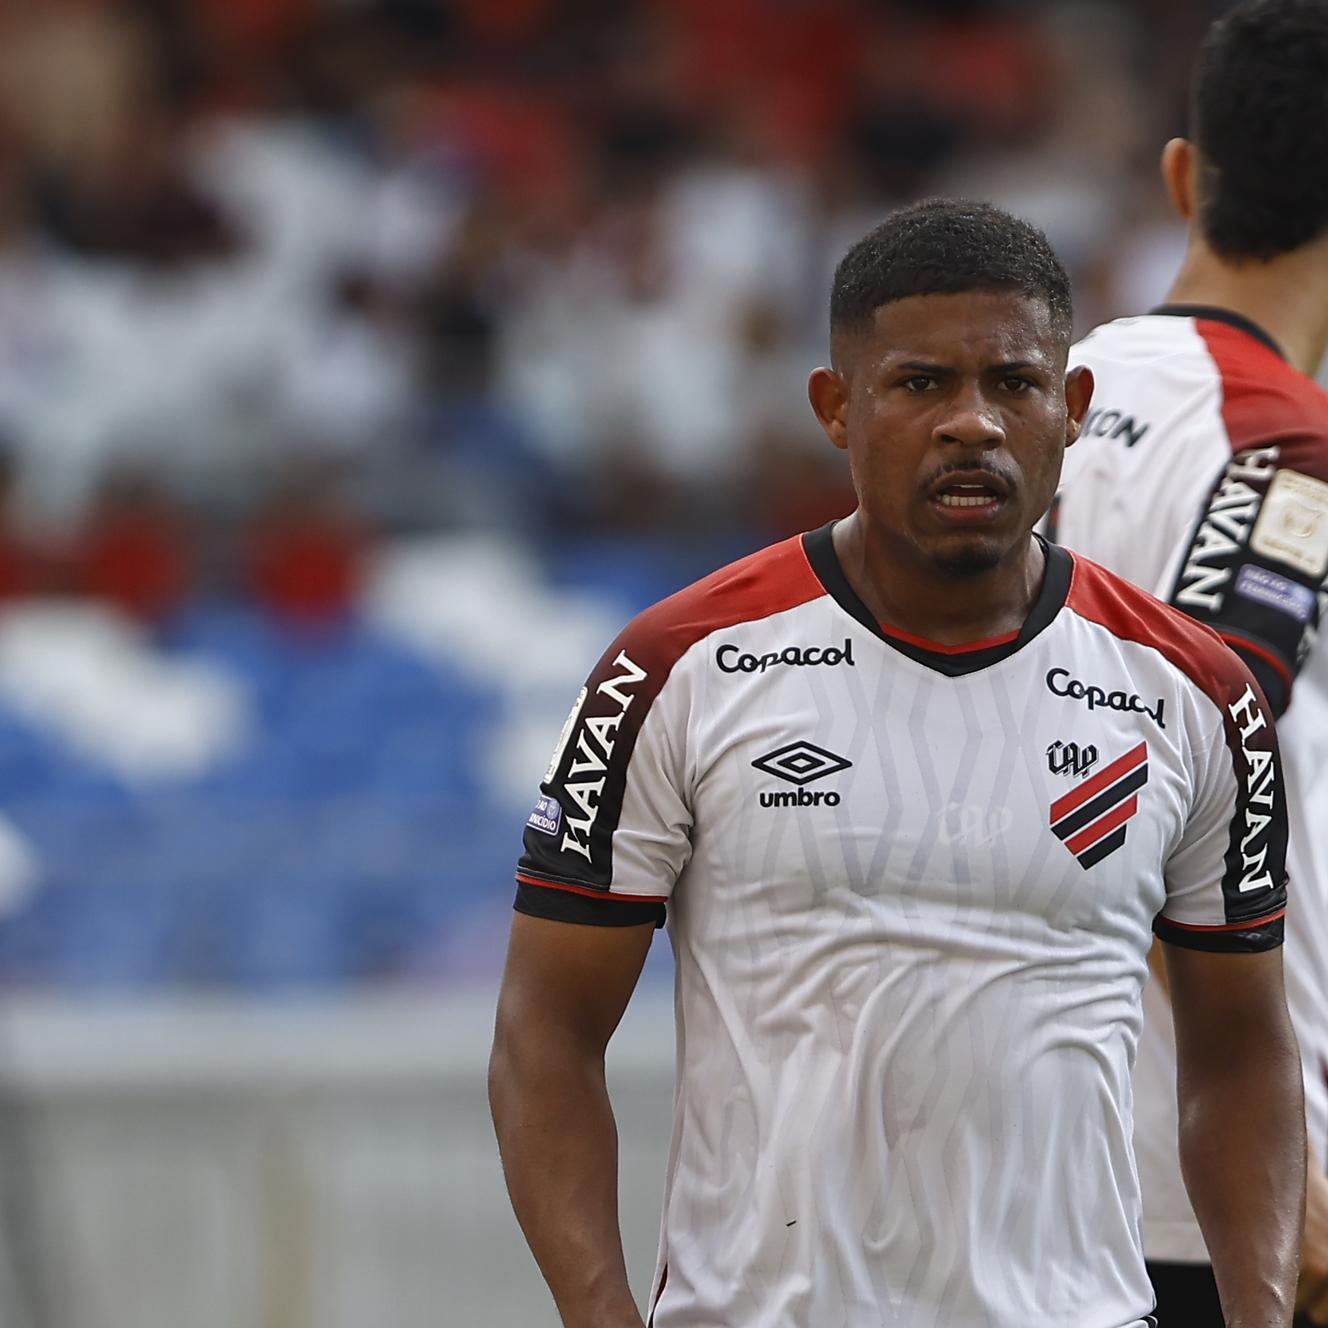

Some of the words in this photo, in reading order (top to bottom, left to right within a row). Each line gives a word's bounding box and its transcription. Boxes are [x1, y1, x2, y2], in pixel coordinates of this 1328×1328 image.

[1175, 446, 1281, 613] HAVAN
[716, 638, 855, 673] Copacol
[1046, 668, 1166, 729] Copacl
[560, 649, 648, 864] HAVAN
[759, 787, 841, 808] umbro
[1228, 683, 1276, 894] HAVAN
